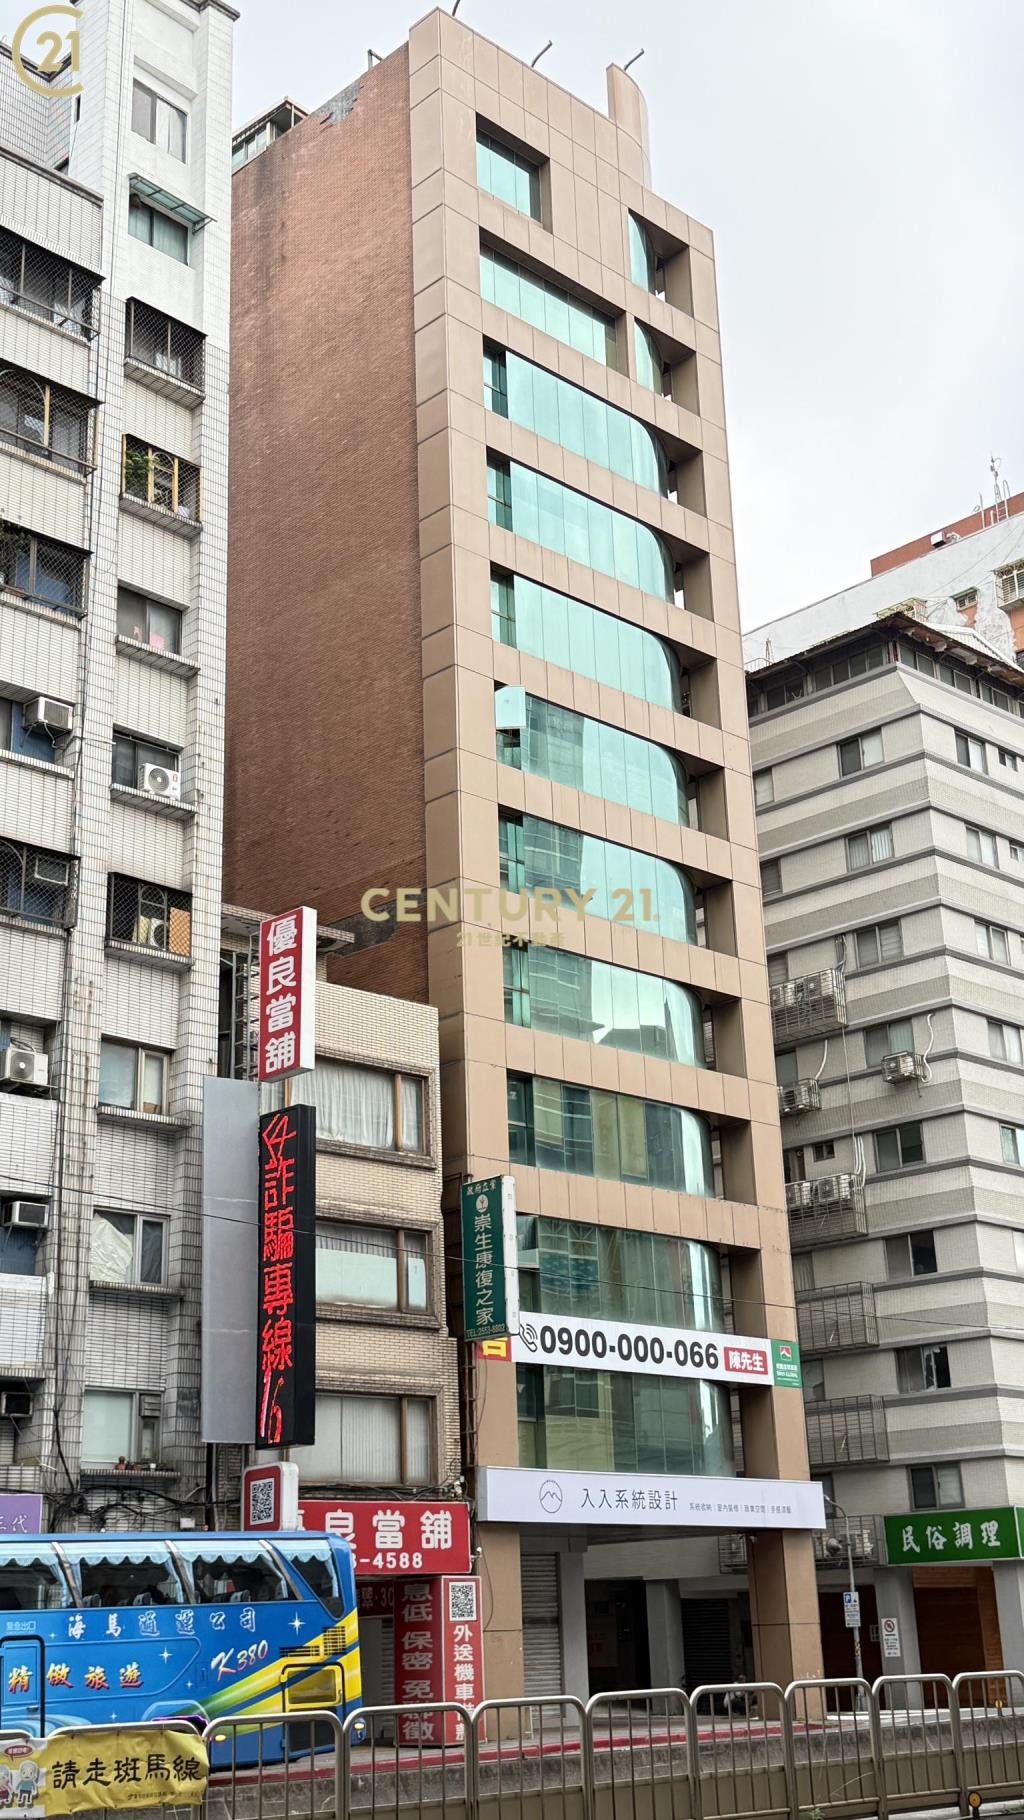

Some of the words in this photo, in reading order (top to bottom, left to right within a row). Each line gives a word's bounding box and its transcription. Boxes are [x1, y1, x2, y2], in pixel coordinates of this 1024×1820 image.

[265, 915, 298, 1074] 優良當舖
[474, 1213, 495, 1327] 崇生康復之家
[539, 1325, 719, 1369] 0900-000-066
[728, 1350, 765, 1372] 陳先生
[298, 1509, 453, 1551] 良當舖
[901, 1519, 1001, 1554] 民俗調理
[210, 1639, 269, 1683] K380
[51, 1753, 204, 1790] 請走斑馬線
